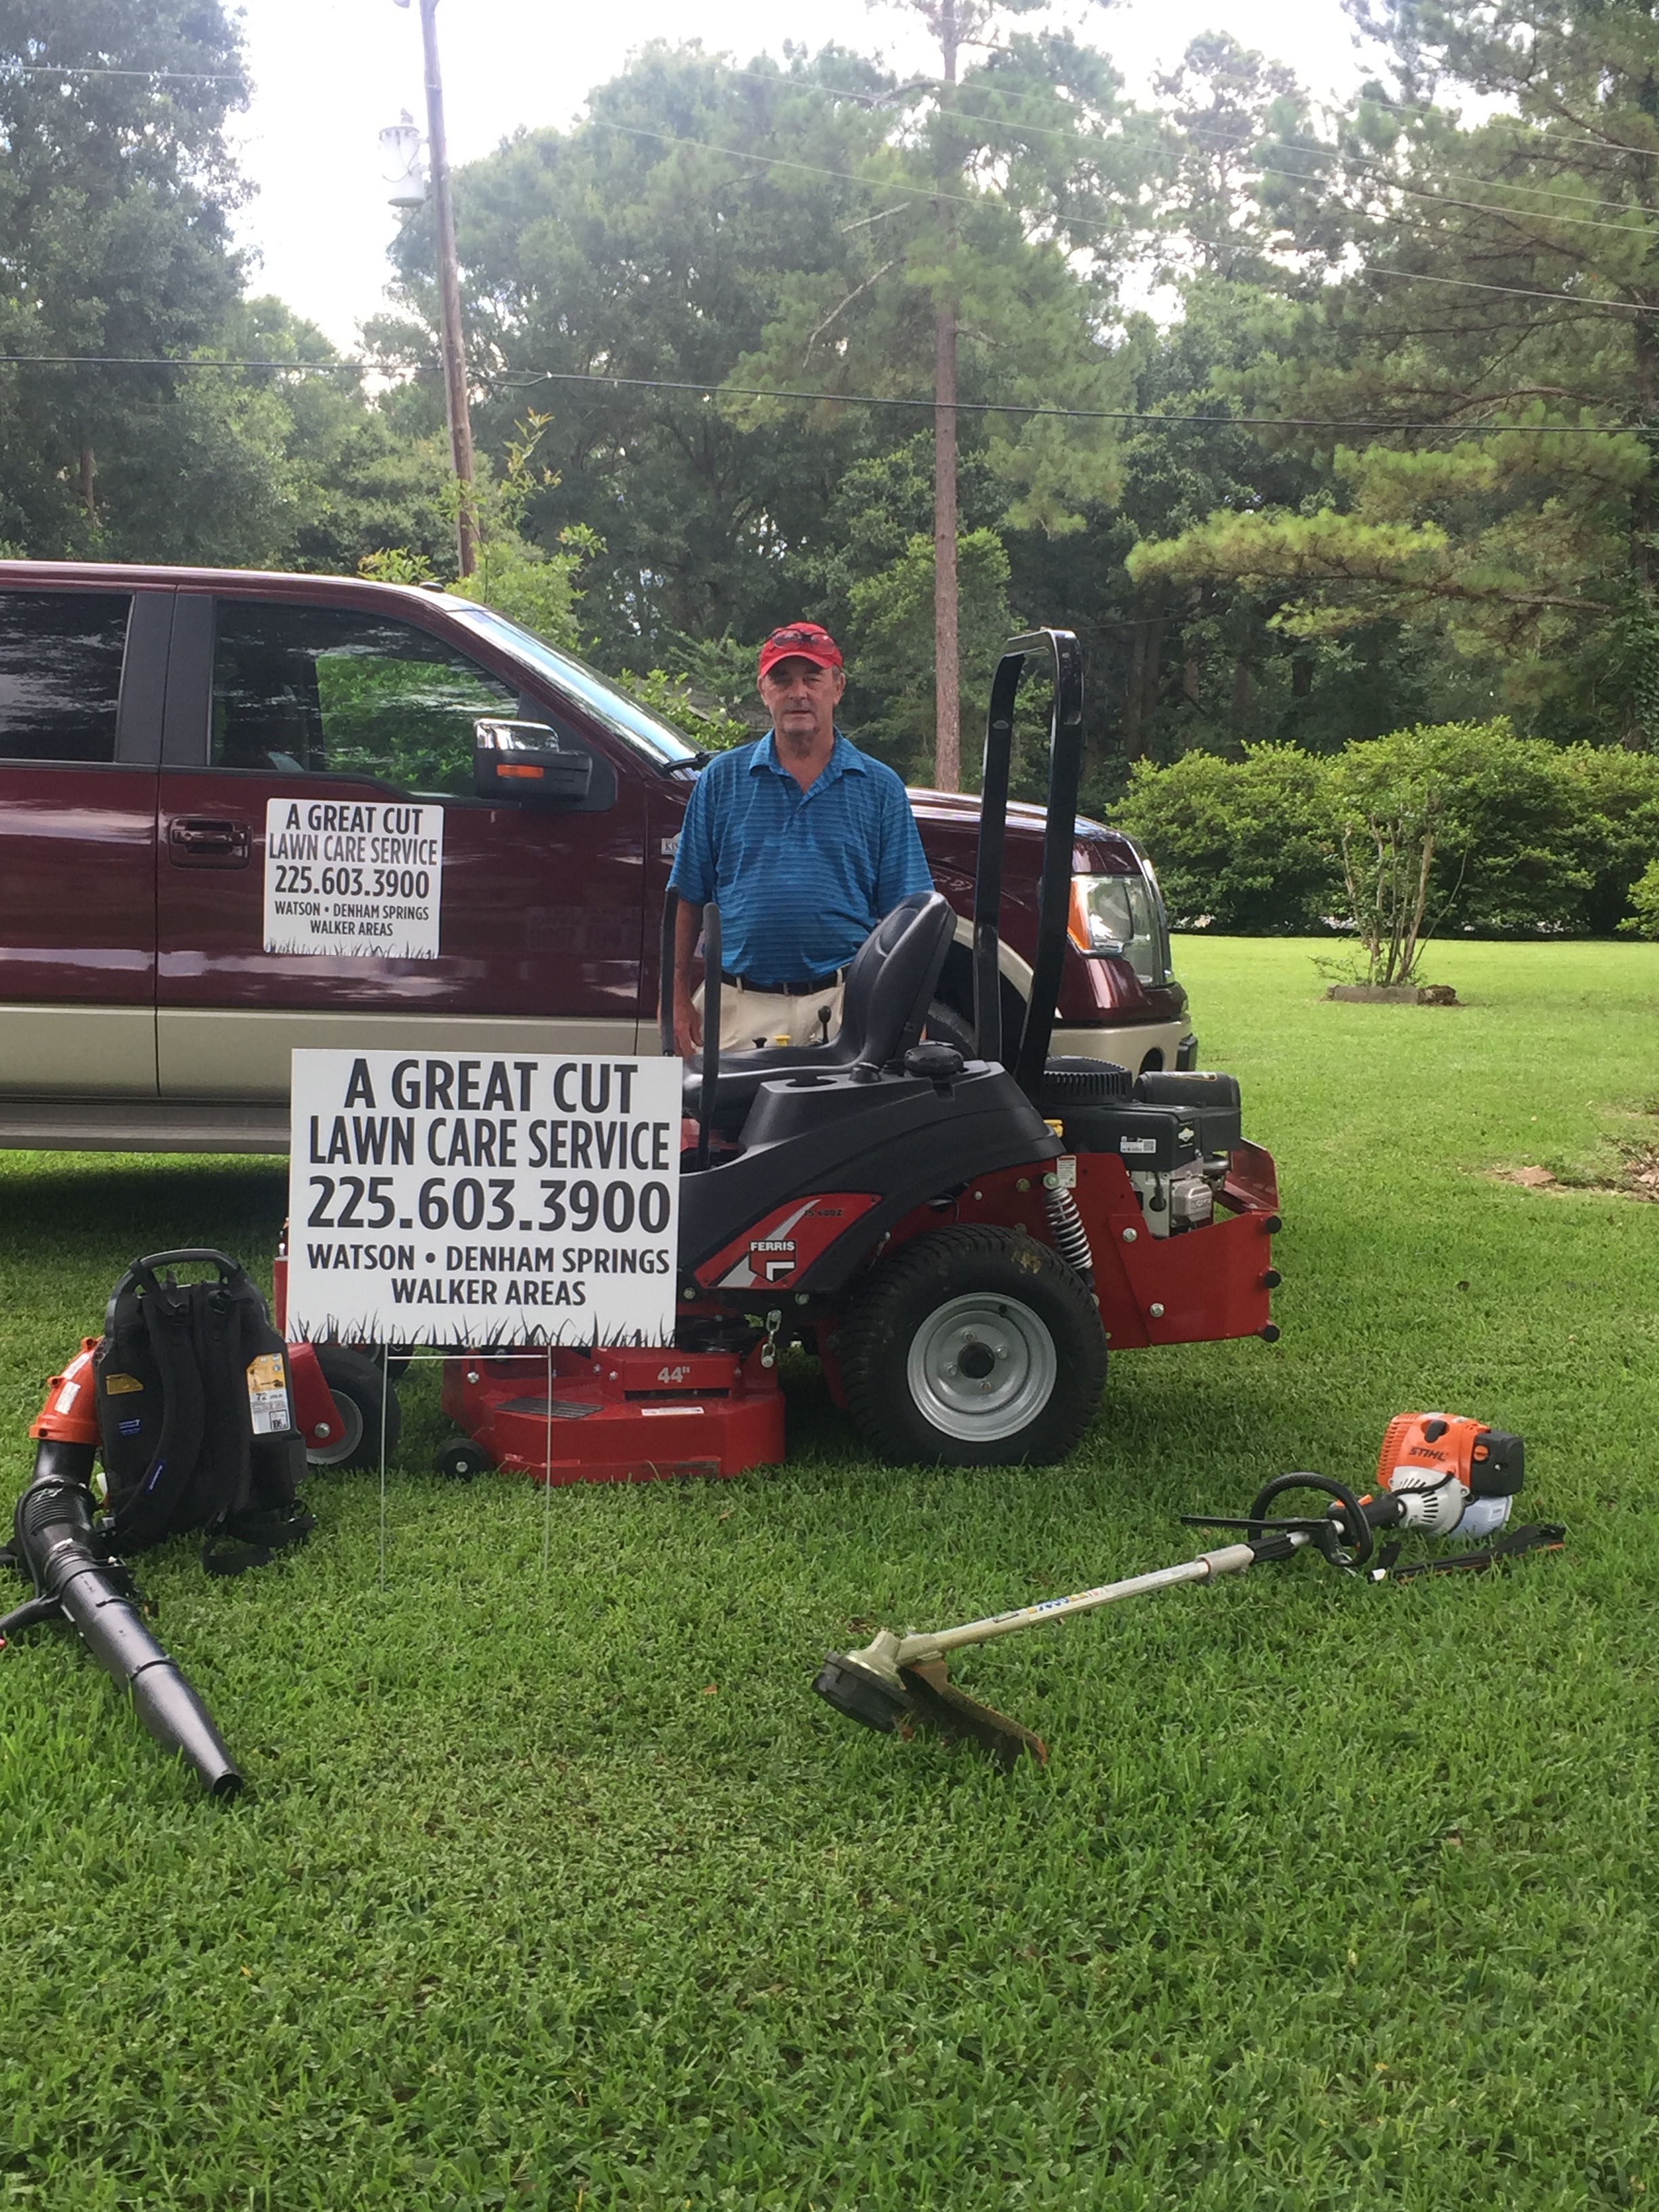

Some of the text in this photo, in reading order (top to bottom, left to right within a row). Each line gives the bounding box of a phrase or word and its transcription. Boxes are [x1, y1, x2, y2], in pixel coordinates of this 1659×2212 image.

[286, 804, 423, 834] A GREAT CUT
[270, 834, 437, 865] LAWN CARE SERVICE
[275, 865, 428, 898] 225.603.3900
[275, 901, 428, 920] WATSON DENHAM SPRINGS
[310, 920, 392, 936] WALKER AREAS
[344, 1059, 638, 1113] A GREAT CUT
[310, 1115, 670, 1170] LAWN CARE SERVICE
[308, 1176, 670, 1233] 225.603.3900
[308, 1244, 669, 1273] WATSON DENHAM SPRINGS
[750, 1242, 795, 1252] FERRIS
[392, 1279, 586, 1305] WALKER AREAS
[1408, 1447, 1446, 1461] STIHL
